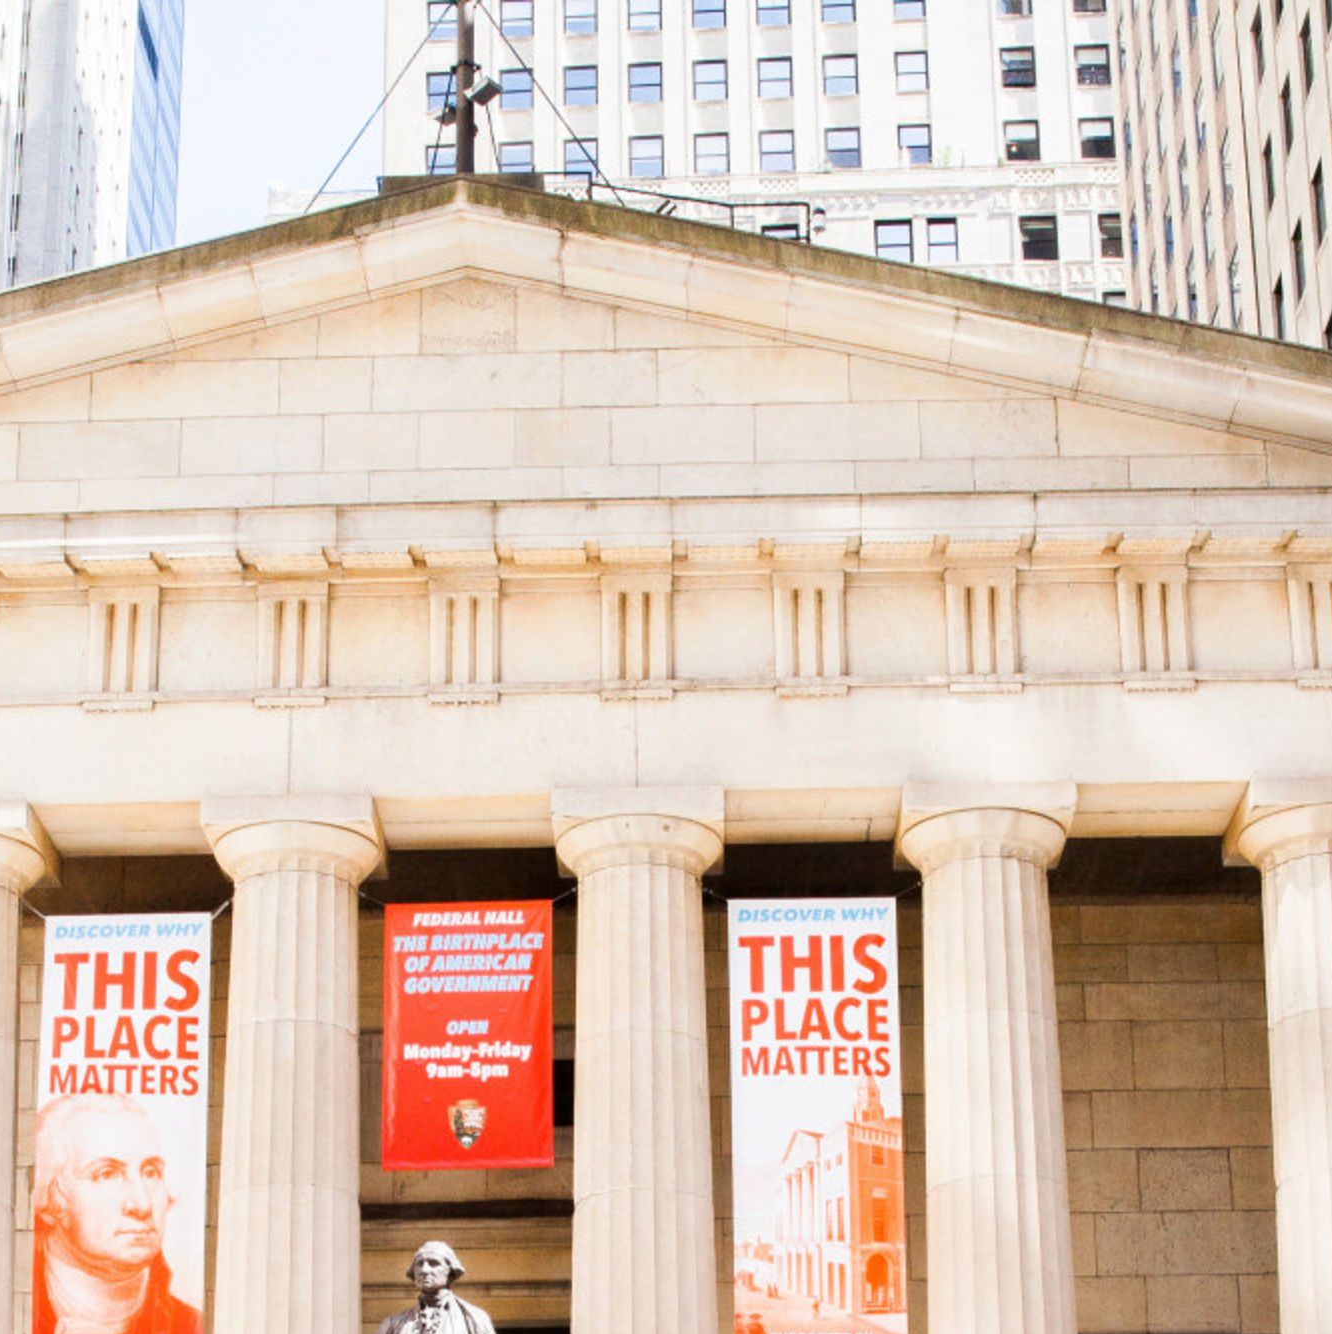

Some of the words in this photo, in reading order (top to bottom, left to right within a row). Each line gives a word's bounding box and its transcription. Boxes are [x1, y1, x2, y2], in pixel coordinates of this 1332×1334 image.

[413, 912, 481, 927] FEDERAL
[484, 910, 525, 926] HALL
[738, 908, 835, 923] DISCOVER
[841, 907, 888, 921] WHY
[55, 923, 152, 939] DISCOVER
[156, 922, 203, 938] WHY
[393, 935, 427, 952] THE
[430, 933, 543, 951] BIRTHPLACE
[404, 955, 430, 973] OF
[432, 953, 532, 972] AMERICAN
[738, 933, 888, 994] THIS
[54, 950, 200, 1011] THIS
[404, 975, 533, 994] GOVERNMENT
[446, 1020, 488, 1035] OPEN
[741, 998, 890, 1042] PLACE
[52, 1016, 199, 1060] PLACE
[403, 1041, 532, 1062] Monday-Friday
[741, 1046, 891, 1078] MATTERS
[49, 1064, 199, 1097] MATTERS
